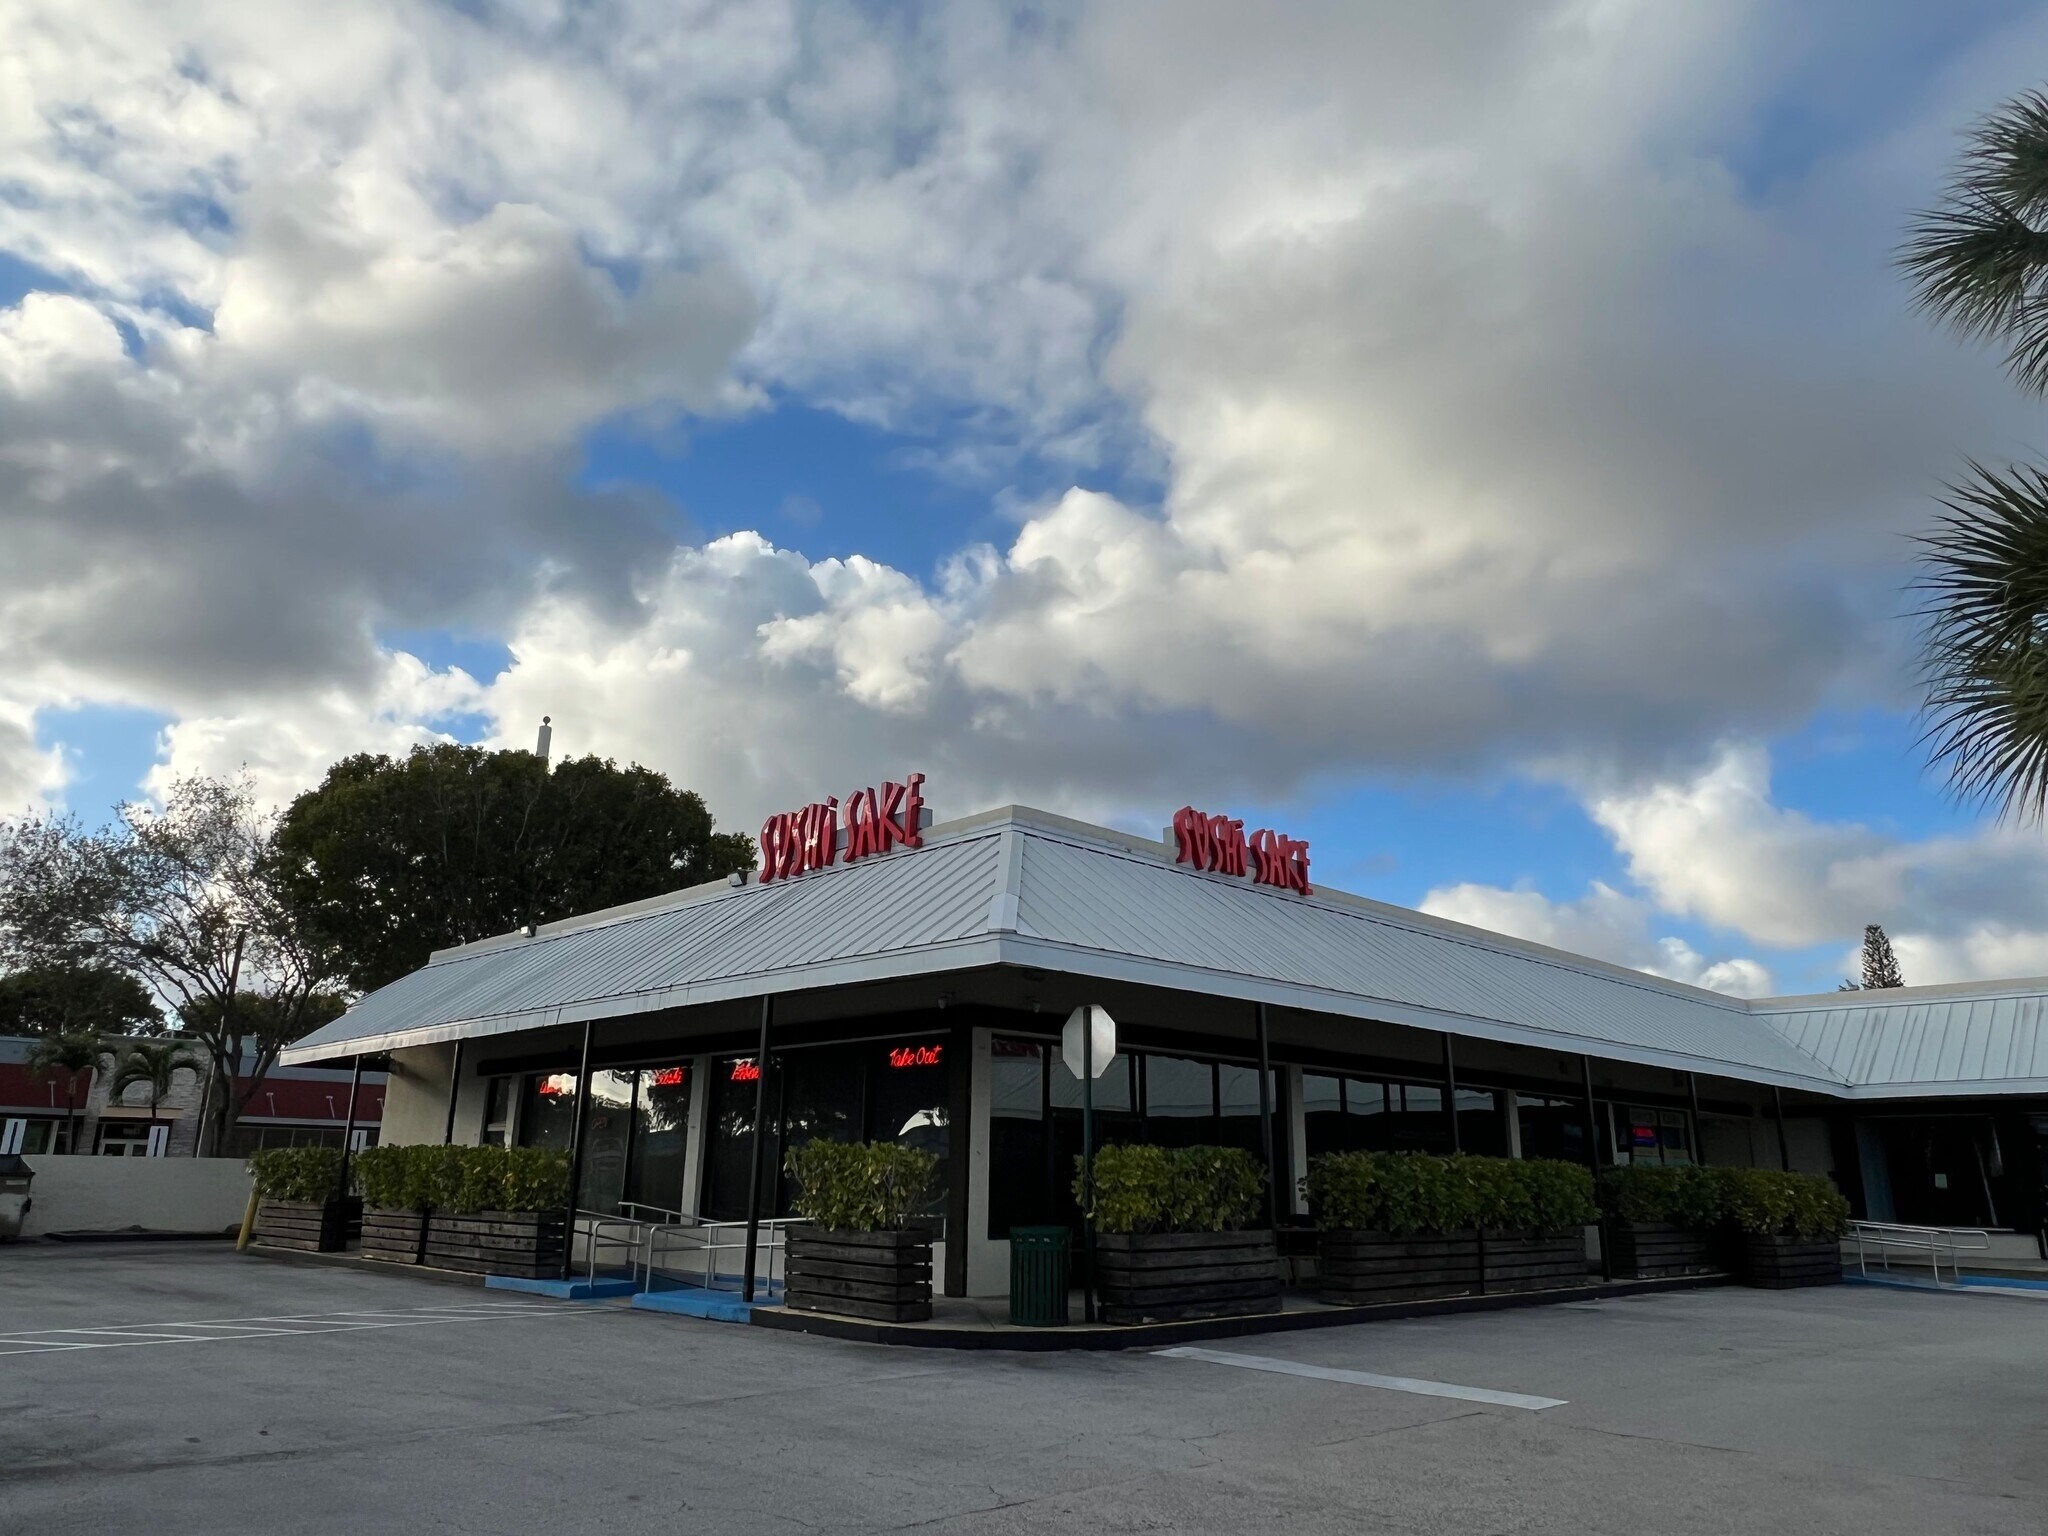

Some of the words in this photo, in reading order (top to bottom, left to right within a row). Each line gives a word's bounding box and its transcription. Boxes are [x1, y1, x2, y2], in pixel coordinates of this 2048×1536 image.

[843, 773, 926, 863] SAKE
[1249, 829, 1313, 895] SAKE
[889, 1047, 915, 1067] Take
[916, 1044, 943, 1065] Out
